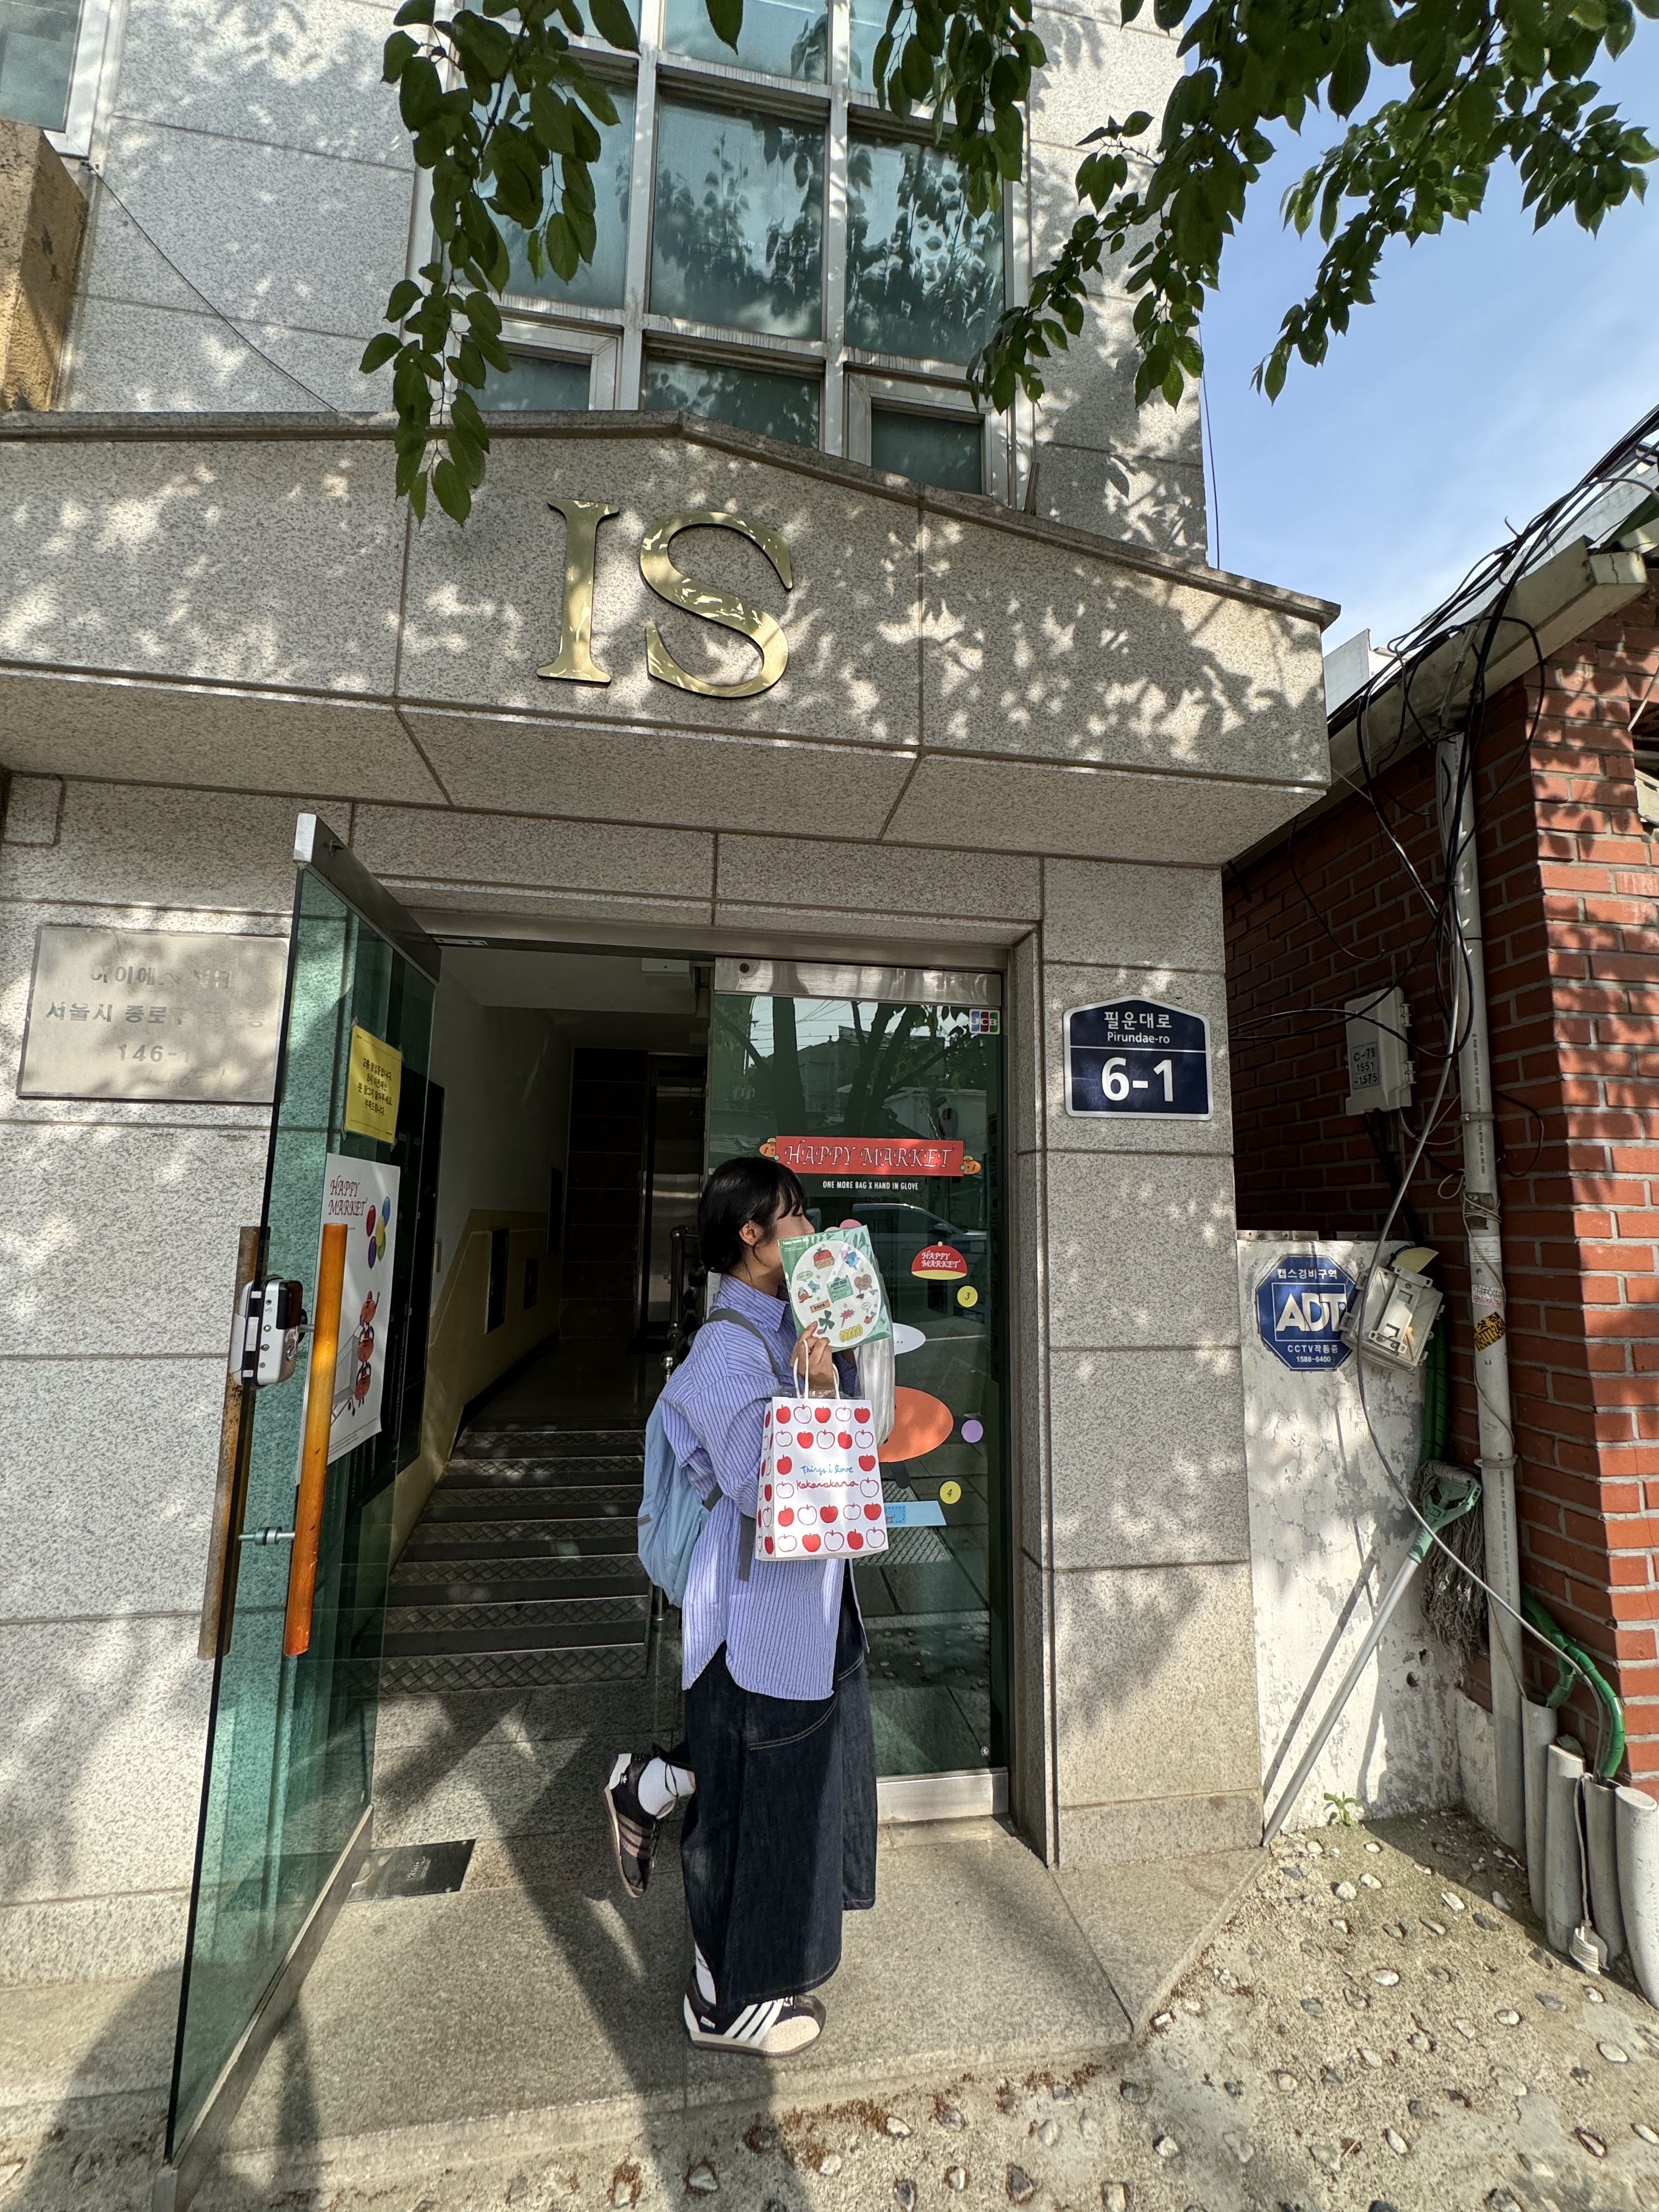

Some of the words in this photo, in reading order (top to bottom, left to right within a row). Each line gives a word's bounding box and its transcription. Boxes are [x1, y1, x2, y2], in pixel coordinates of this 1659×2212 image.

[536, 498, 793, 699] IS
[46, 1001, 113, 1023] 서울시
[970, 1018, 997, 1026] JCB
[1104, 1011, 1172, 1030] 필운대로
[1107, 1031, 1170, 1044] Pirundae-ro
[117, 1043, 190, 1063] 146-1
[1353, 1047, 1375, 1062] C-79
[1356, 1060, 1375, 1073] 1551
[1102, 1057, 1173, 1102] 6-1
[1353, 1073, 1378, 1086] -1575
[784, 1138, 857, 1166] HAPPY
[860, 1143, 956, 1169] MARKET
[330, 1175, 360, 1198] HAPPY
[822, 1180, 835, 1189] ONE
[836, 1180, 854, 1189] MORE
[854, 1181, 867, 1189] BAG
[873, 1181, 890, 1190] HAND
[891, 1182, 899, 1190] IN
[900, 1182, 919, 1190] GLOVE
[328, 1197, 368, 1216] MARKET
[921, 1249, 951, 1261] HAPPY
[921, 1259, 961, 1269] MARKET
[1277, 1268, 1338, 1279] 캡스경비구역
[964, 1292, 970, 1301] 3
[1276, 1293, 1347, 1331] ADT
[1287, 1344, 1338, 1354] CCTV작동중
[834, 1464, 854, 1474] love
[946, 1488, 953, 1498] 4
